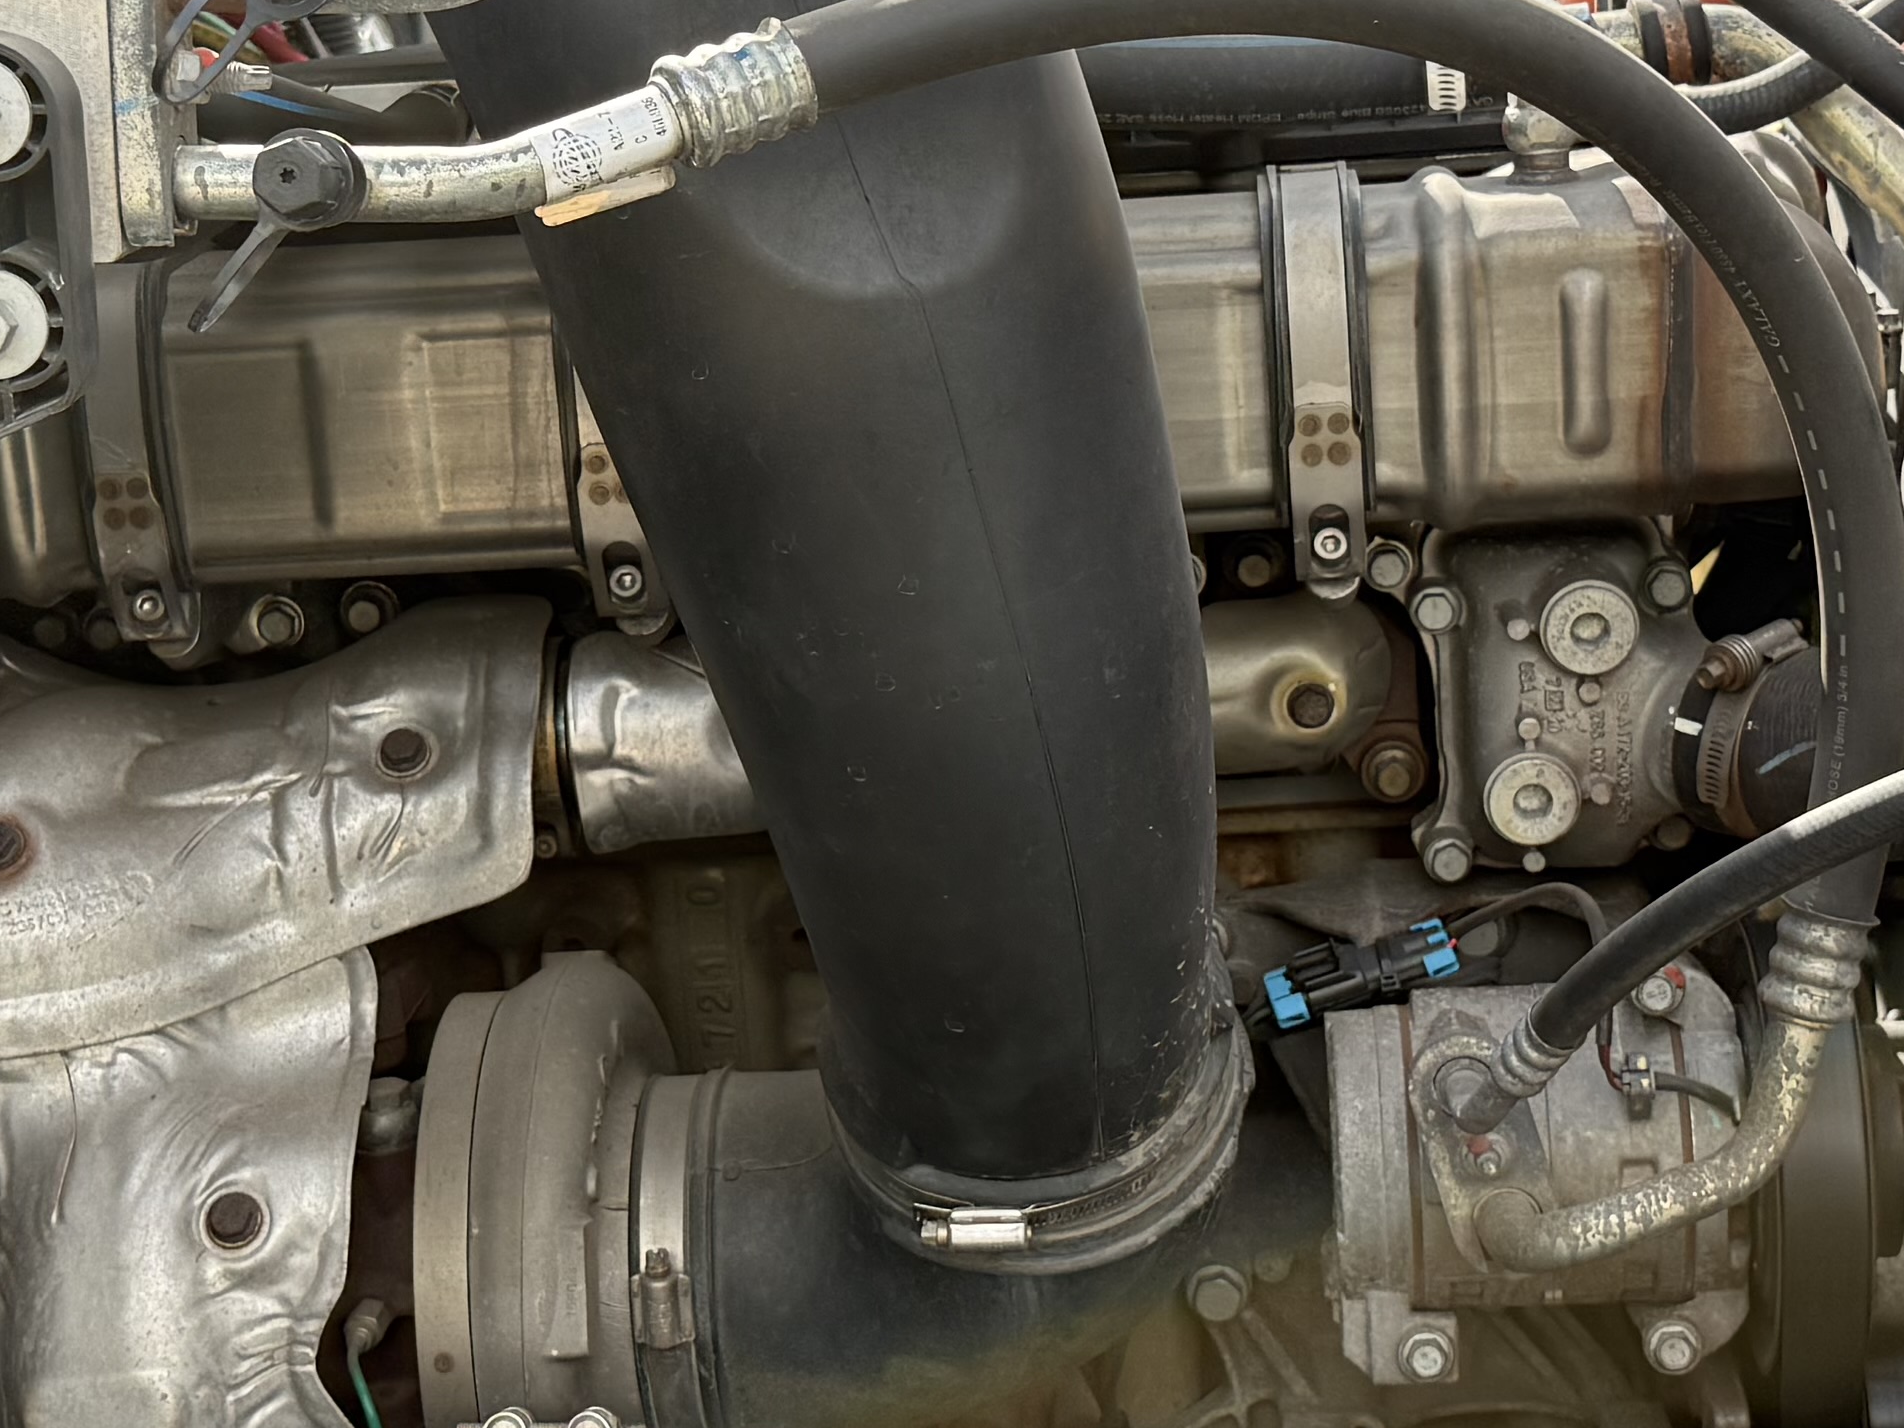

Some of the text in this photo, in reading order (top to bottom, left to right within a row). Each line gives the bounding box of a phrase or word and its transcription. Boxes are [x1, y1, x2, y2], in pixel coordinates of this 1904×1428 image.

[1732, 280, 1781, 349] GALAXY
[1836, 680, 1849, 703] 3/4
[1831, 706, 1849, 757] (19mm)
